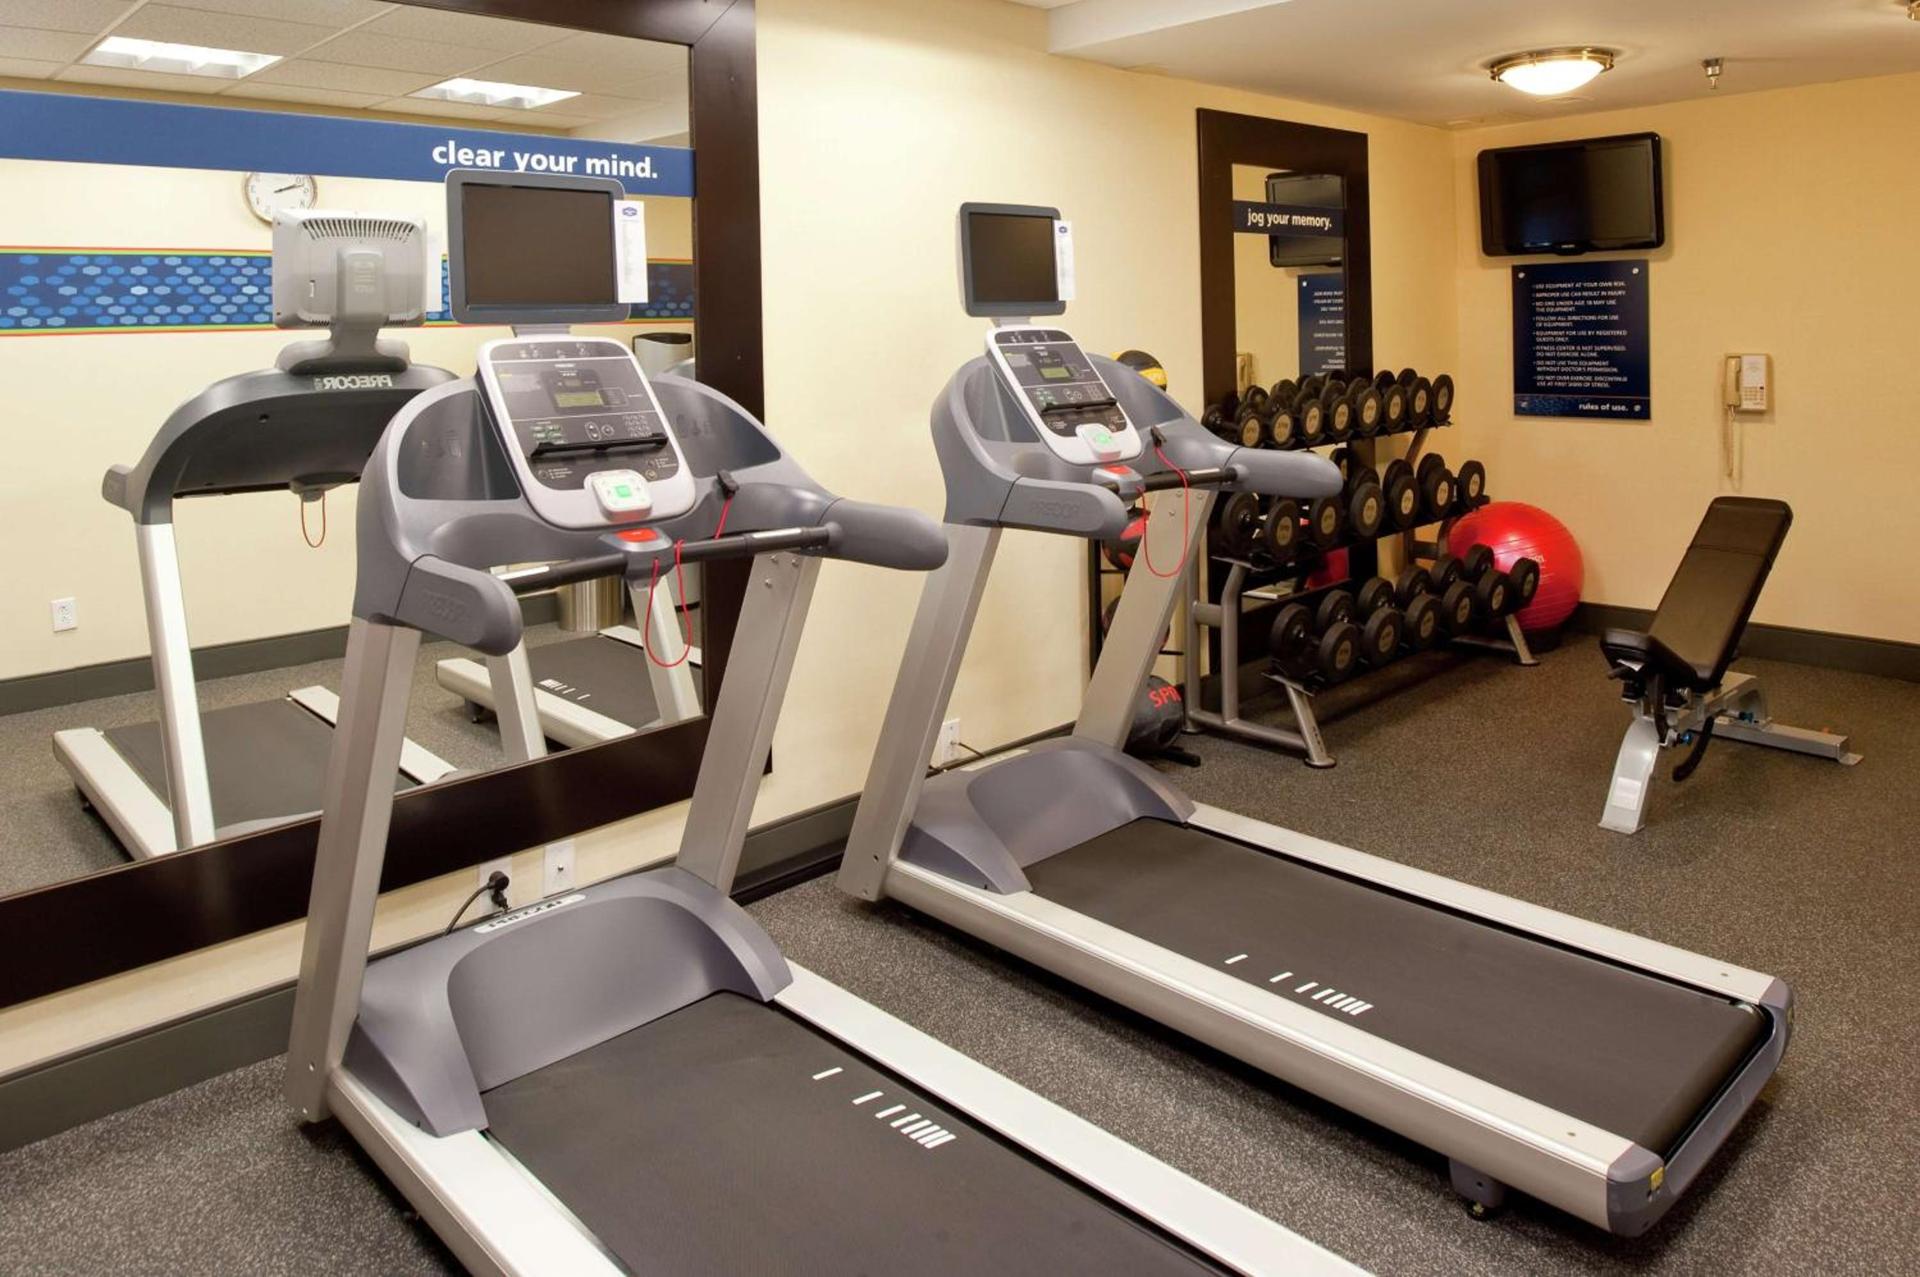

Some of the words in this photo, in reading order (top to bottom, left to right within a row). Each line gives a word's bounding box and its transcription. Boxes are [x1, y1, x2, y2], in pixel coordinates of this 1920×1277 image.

[432, 140, 505, 167] clear
[514, 152, 578, 172] your
[585, 154, 658, 179] mind.
[1247, 207, 1264, 227] jog
[1267, 212, 1290, 227] your
[1291, 215, 1332, 231] memory.
[1579, 402, 1599, 411] rules
[1600, 403, 1610, 411] of
[1611, 404, 1629, 412] use.
